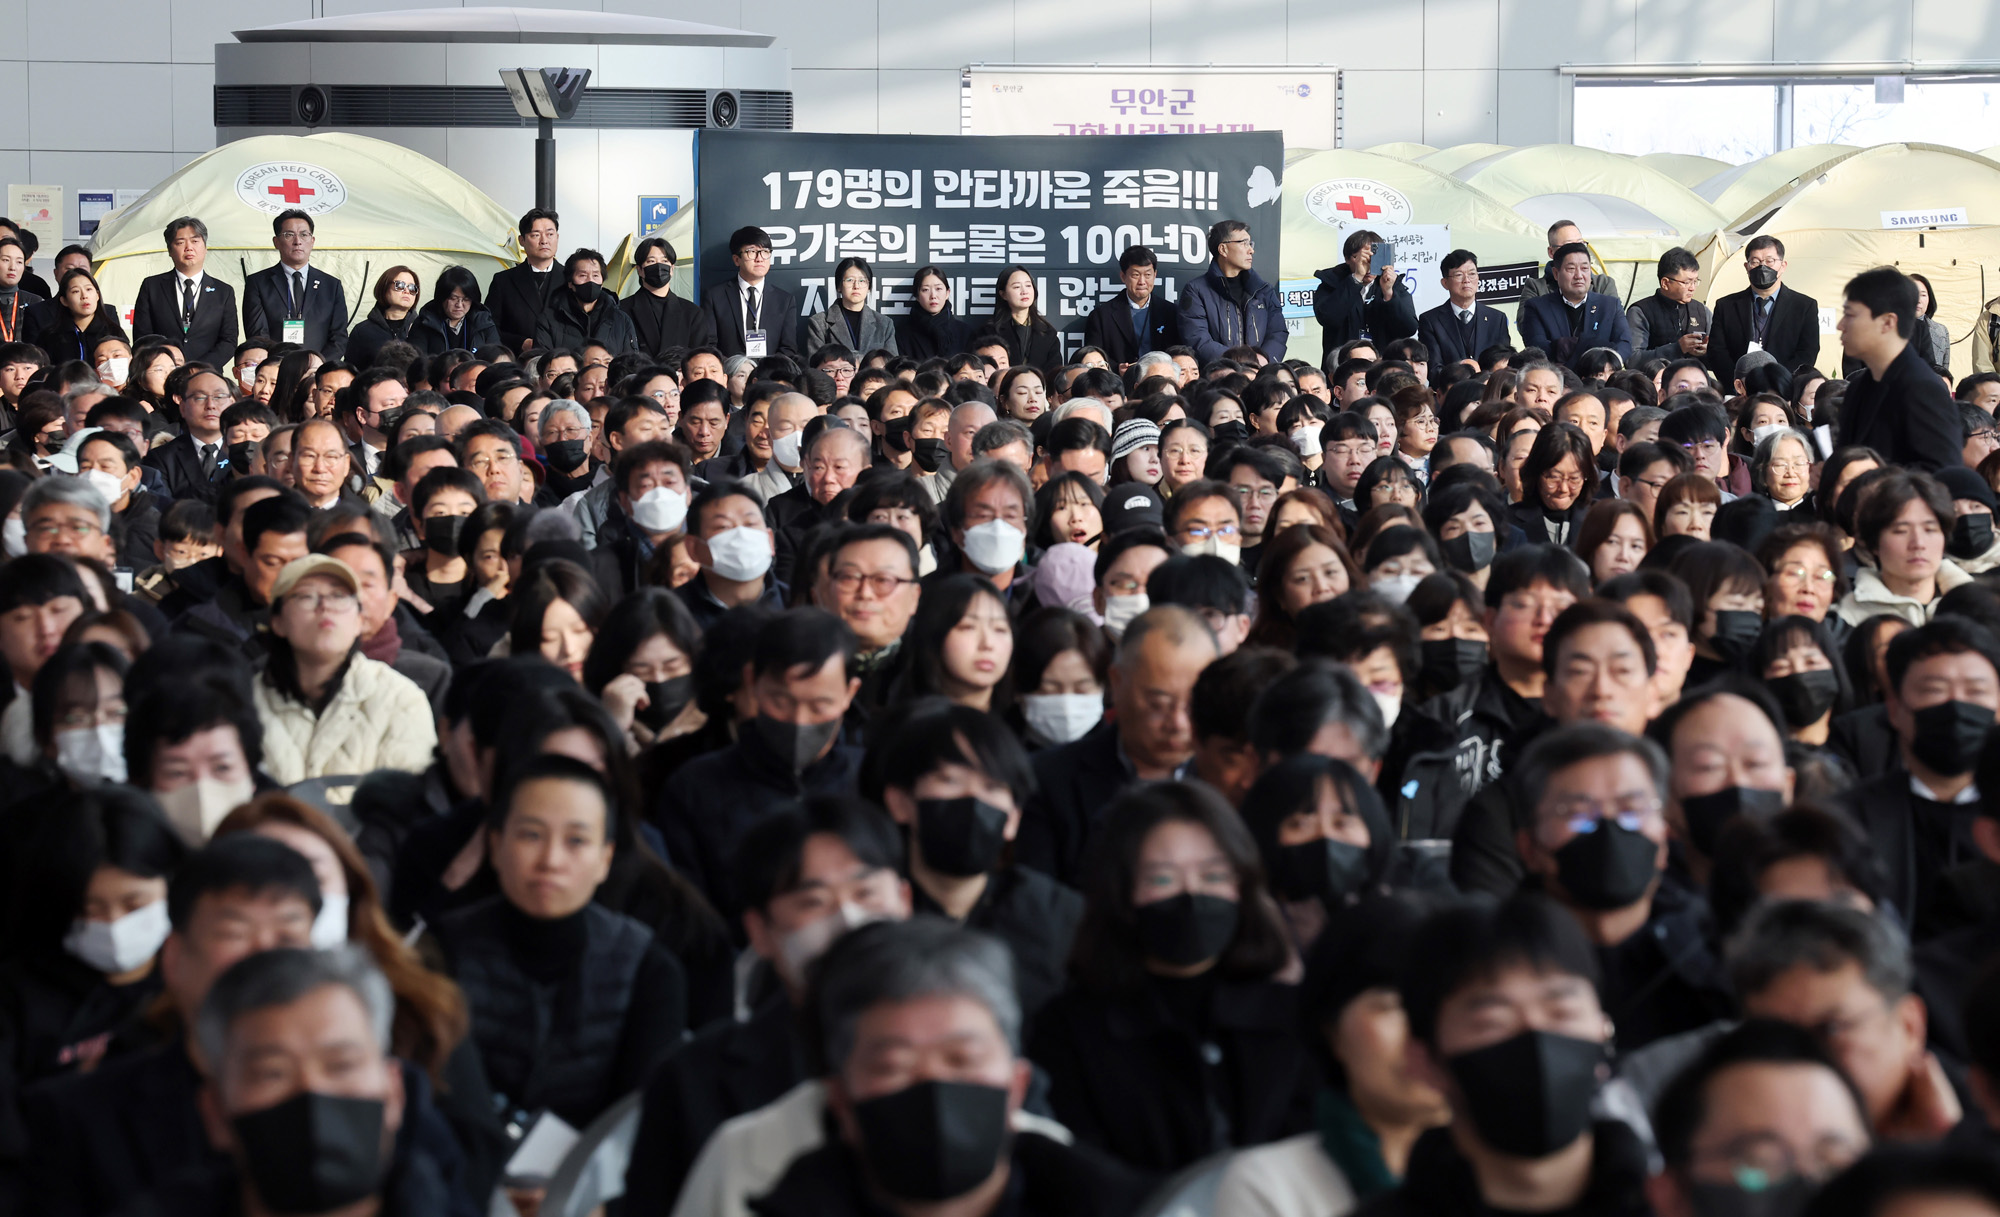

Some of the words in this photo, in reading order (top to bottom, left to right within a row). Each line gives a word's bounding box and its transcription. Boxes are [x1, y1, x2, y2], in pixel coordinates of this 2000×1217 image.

[1109, 88, 1196, 116] 무안군
[243, 165, 279, 191] KOREAN
[280, 165, 308, 174] RED
[309, 170, 339, 194] CROSS
[762, 168, 922, 211] 179명의
[933, 168, 1092, 210] 안타까운
[1102, 168, 1219, 211] 죽음!!!
[1312, 181, 1344, 206] KOREAN
[1344, 182, 1371, 191] RED
[1373, 187, 1404, 211] CROSS
[1890, 213, 1959, 226] SAMSUNG
[760, 222, 917, 266] 유가족의
[928, 223, 1046, 264] 눈물은
[1411, 251, 1437, 263] 지킴이
